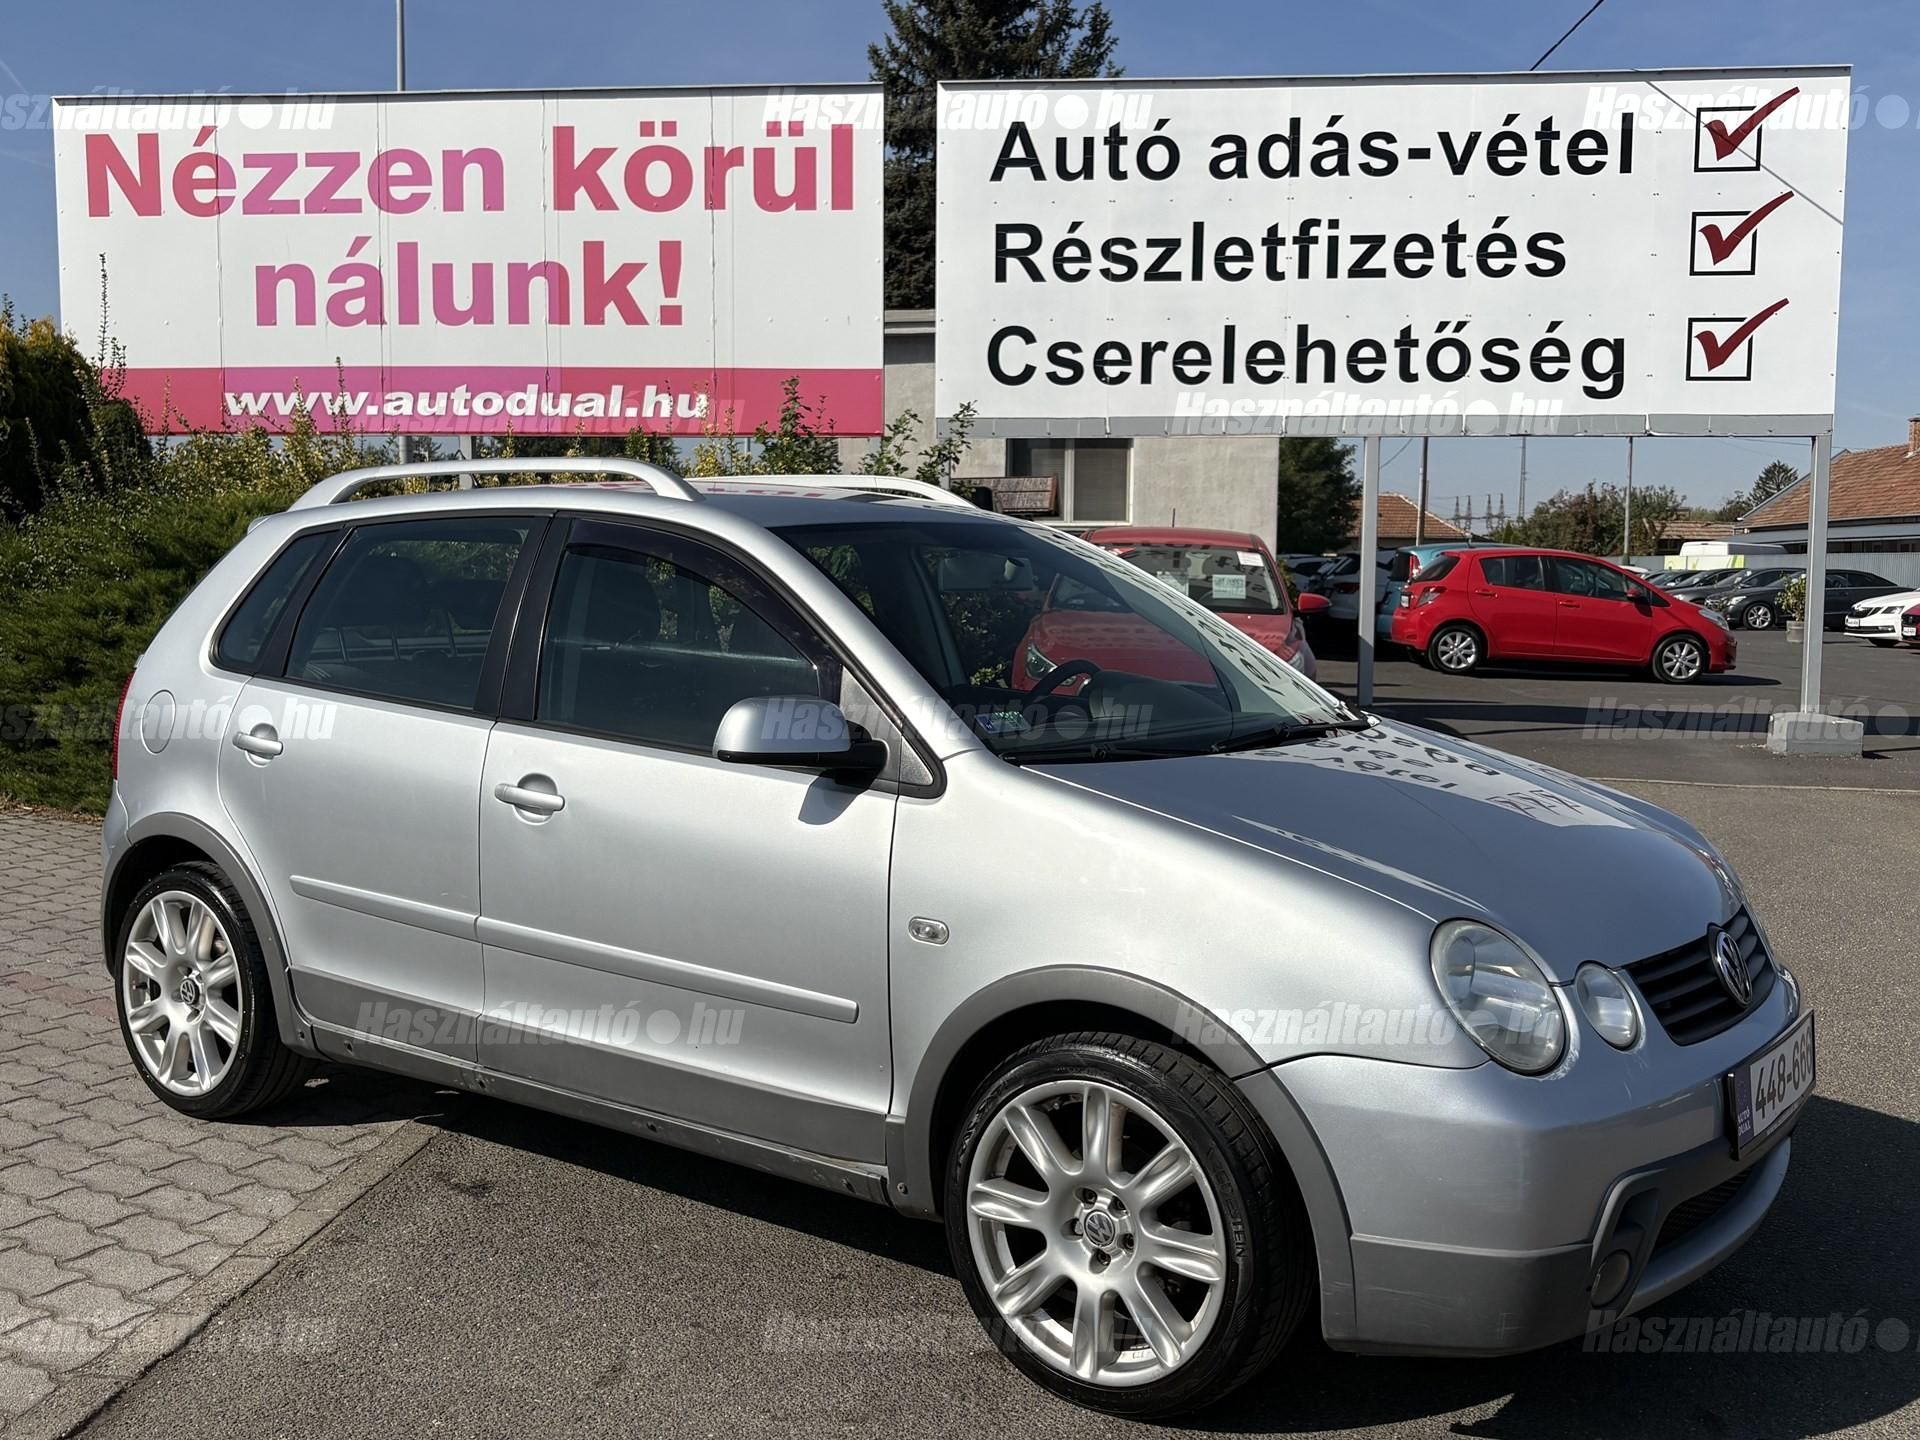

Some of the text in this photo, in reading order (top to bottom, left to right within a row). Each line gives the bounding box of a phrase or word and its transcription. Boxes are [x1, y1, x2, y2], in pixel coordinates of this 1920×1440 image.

[85, 120, 854, 218] Nézzen körül
[990, 113, 1634, 182] Autó adás-vétel
[255, 236, 683, 327] nálunk!
[995, 216, 1566, 283] Részletfizetés
[987, 320, 1625, 400] Cserelehetőség
[224, 384, 708, 418] www.autodual.hu
